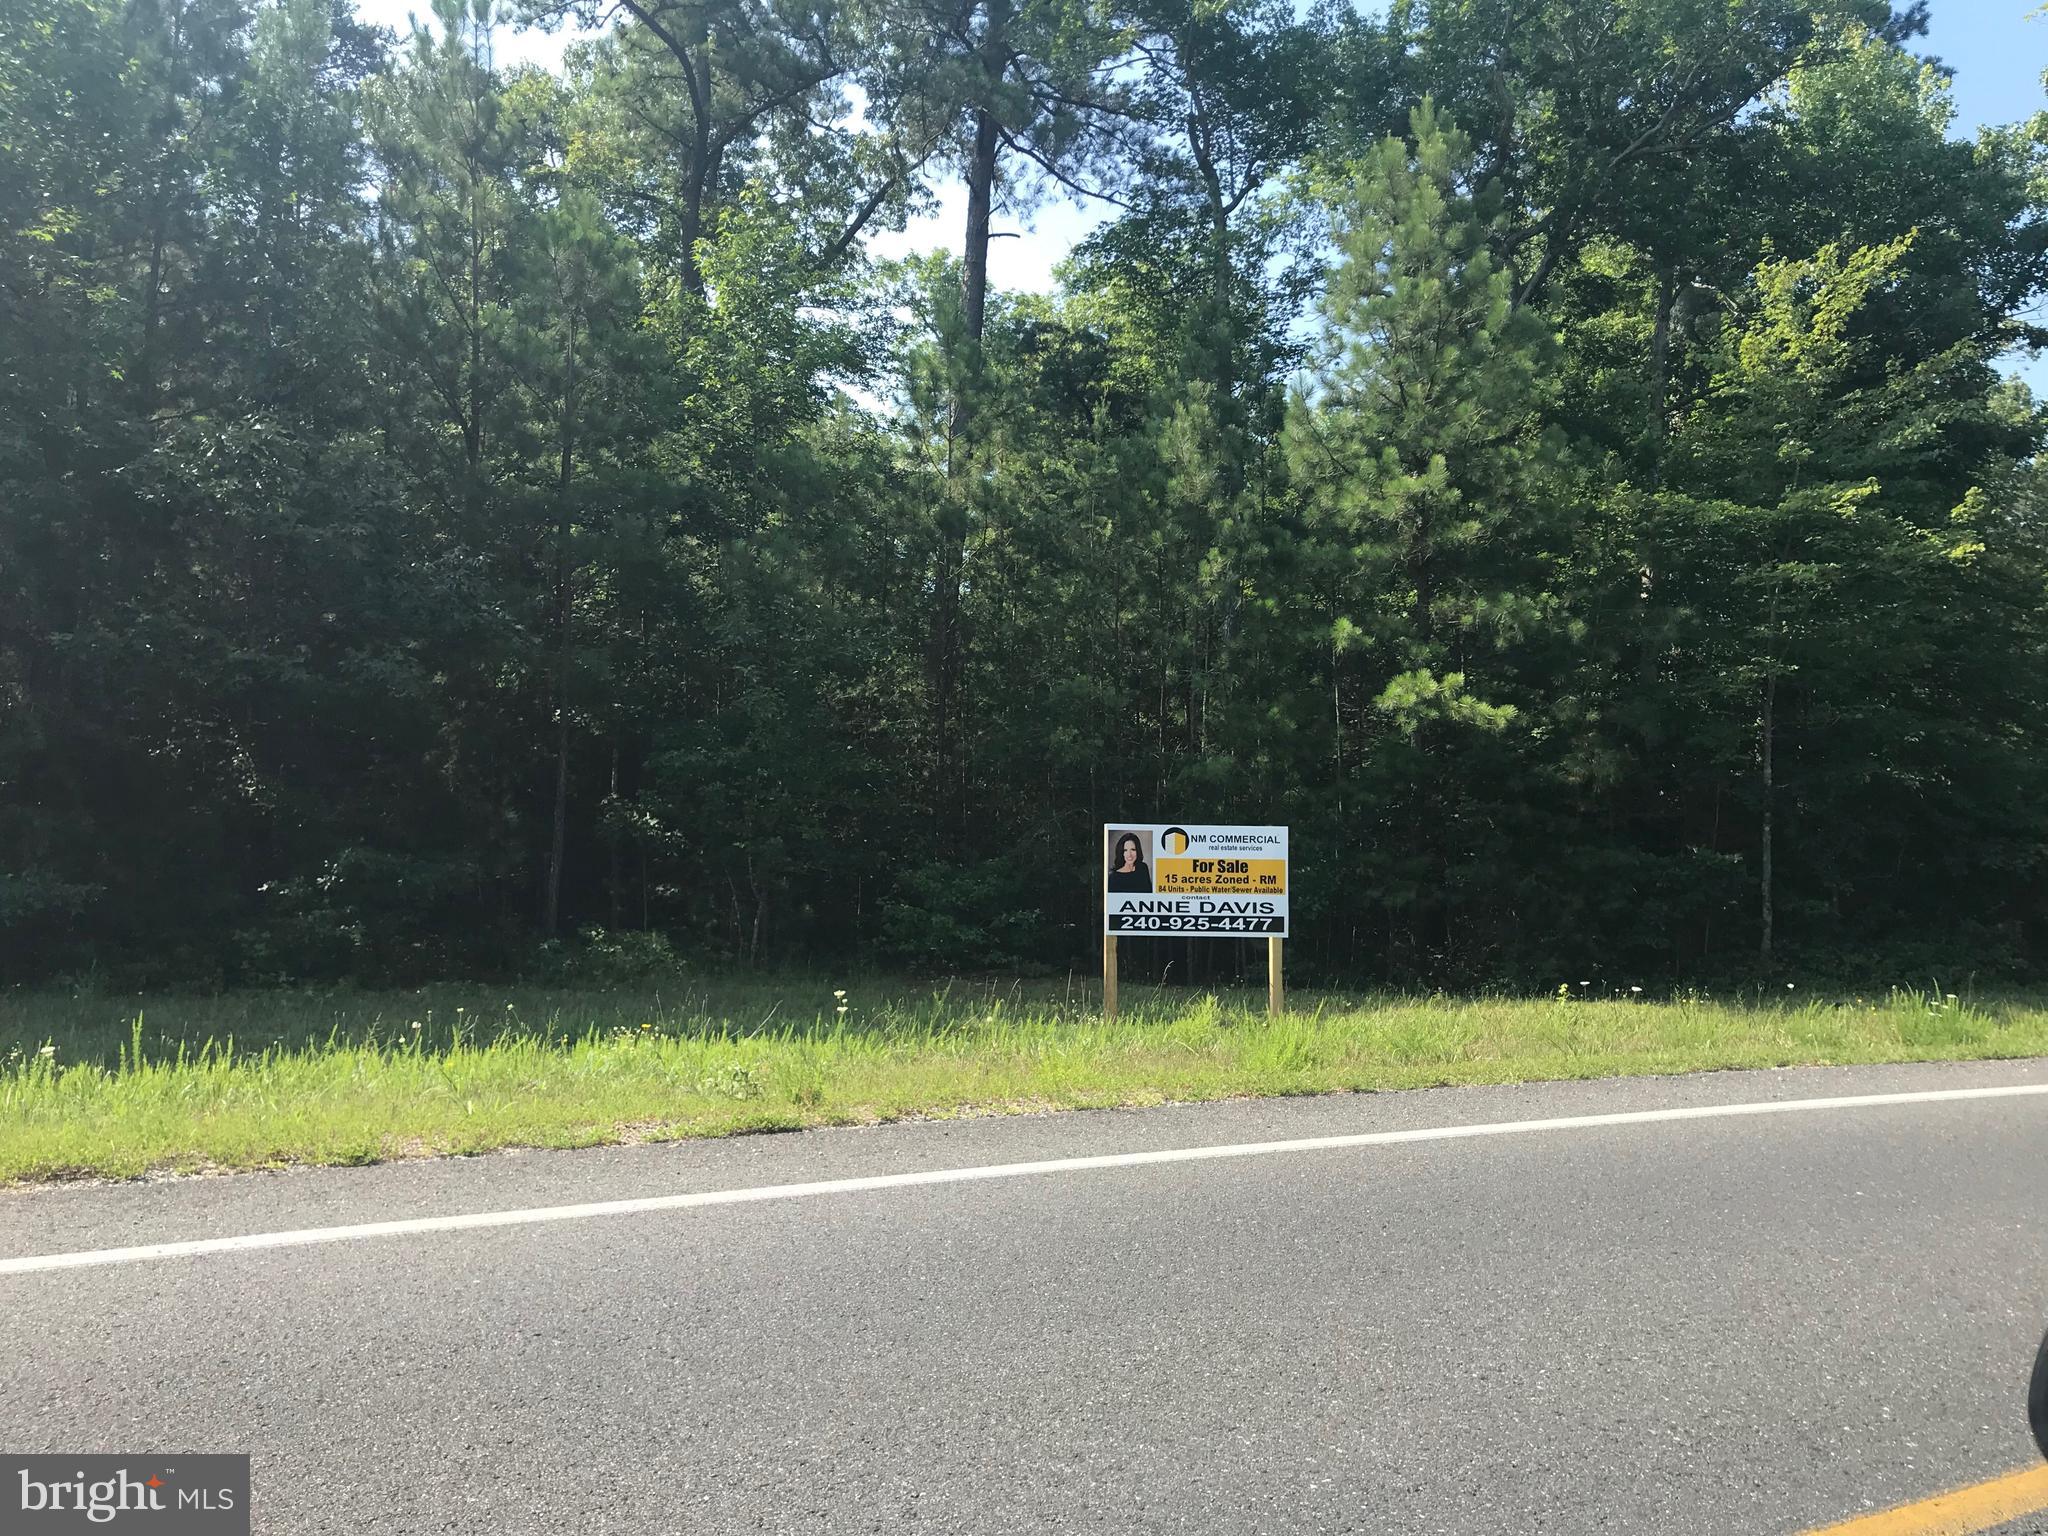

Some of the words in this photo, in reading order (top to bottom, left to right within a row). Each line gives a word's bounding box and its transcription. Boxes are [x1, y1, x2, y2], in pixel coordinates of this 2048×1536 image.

[1191, 834, 1206, 842] NM
[1210, 835, 1280, 844] COMMERCIAL
[1192, 860, 1214, 873] For
[1217, 860, 1248, 873] Sale
[1165, 875, 1178, 883] 15
[1215, 875, 1249, 884] Zoned
[1260, 876, 1276, 884] RM
[1120, 901, 1190, 912] ANNE
[1200, 902, 1274, 914] DAVIS
[1121, 917, 1272, 930] 240-925-4477
